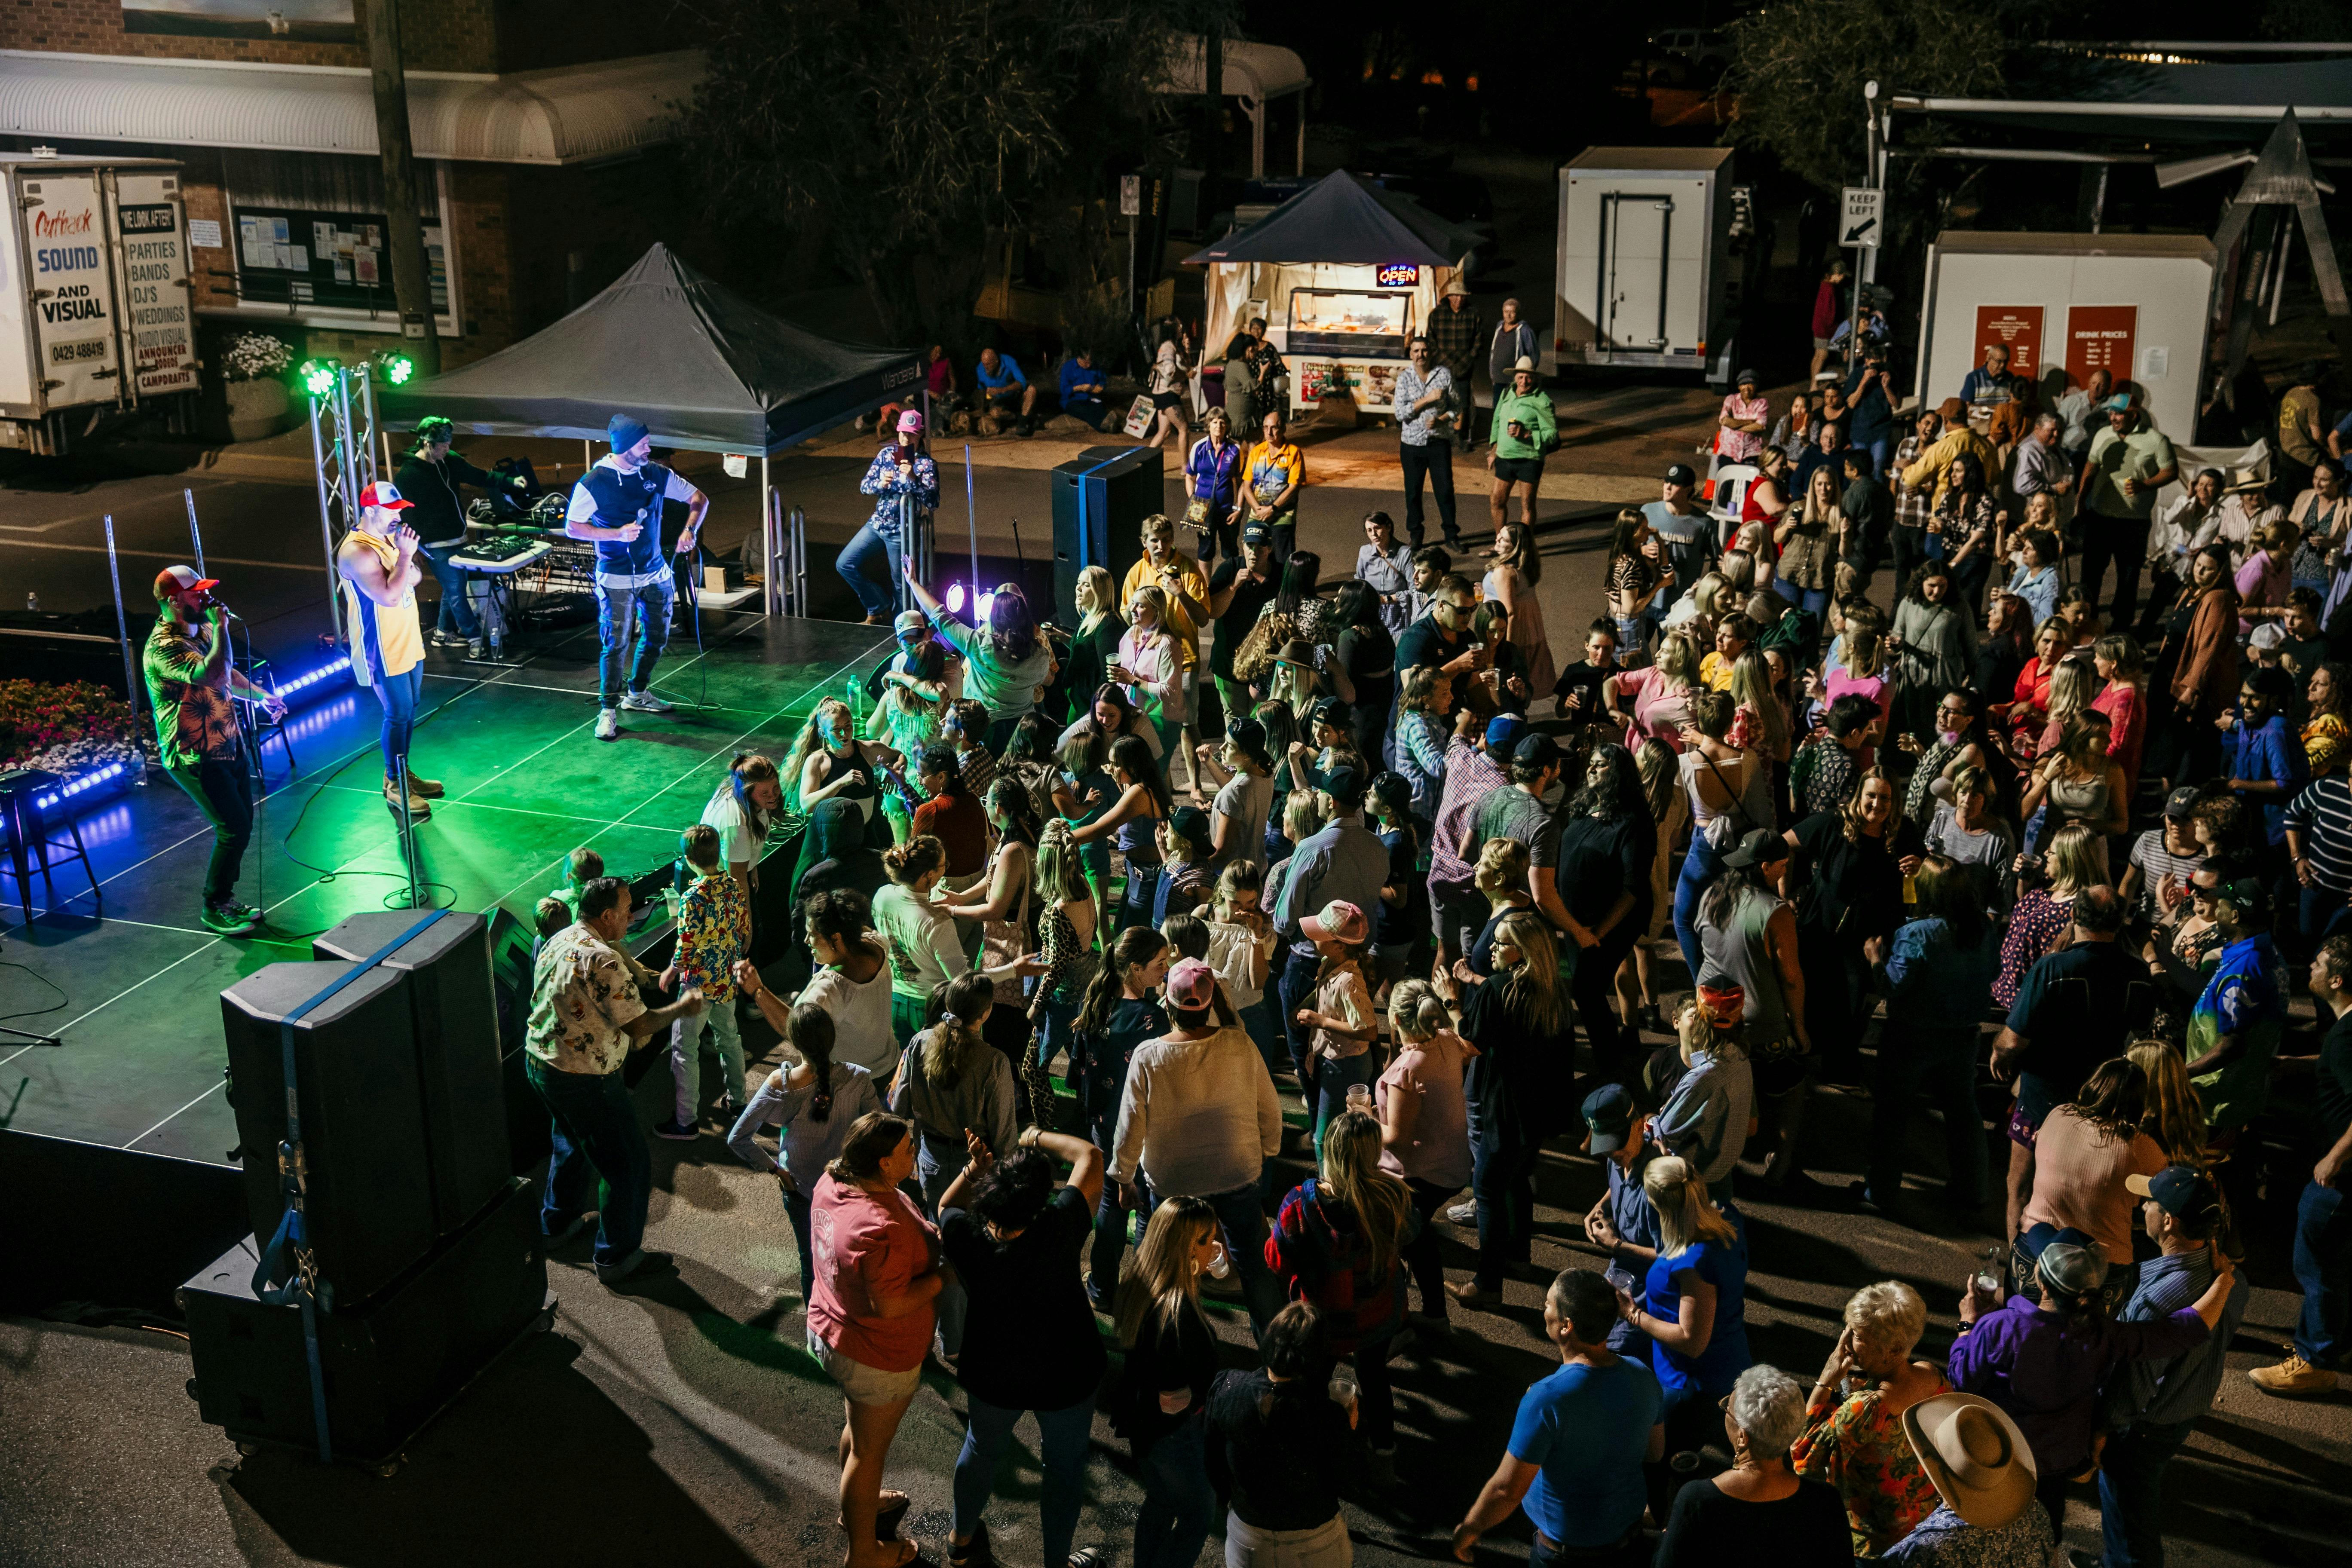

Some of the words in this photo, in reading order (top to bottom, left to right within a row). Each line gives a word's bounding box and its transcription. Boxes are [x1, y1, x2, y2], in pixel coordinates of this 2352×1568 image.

[1850, 194, 1876, 204] KEEP
[1850, 205, 1874, 215] LEFT
[129, 241, 176, 260] PARTIES
[38, 246, 98, 273] SOUND
[132, 263, 170, 282] BANDS
[1379, 270, 1416, 282] OPEN
[57, 285, 89, 299] AND
[133, 285, 157, 303] DJ'S
[41, 298, 107, 323] VISUAL
[135, 305, 185, 325] WEDDINGS
[138, 330, 159, 348] AUDIO
[159, 328, 187, 346] VISUAL
[2075, 331, 2100, 339] DRINK
[2101, 330, 2128, 339] PRICES
[53, 345, 74, 361] 0429
[139, 344, 187, 360] ANNOUNCER
[141, 371, 190, 387] CAMPDRAFTS
